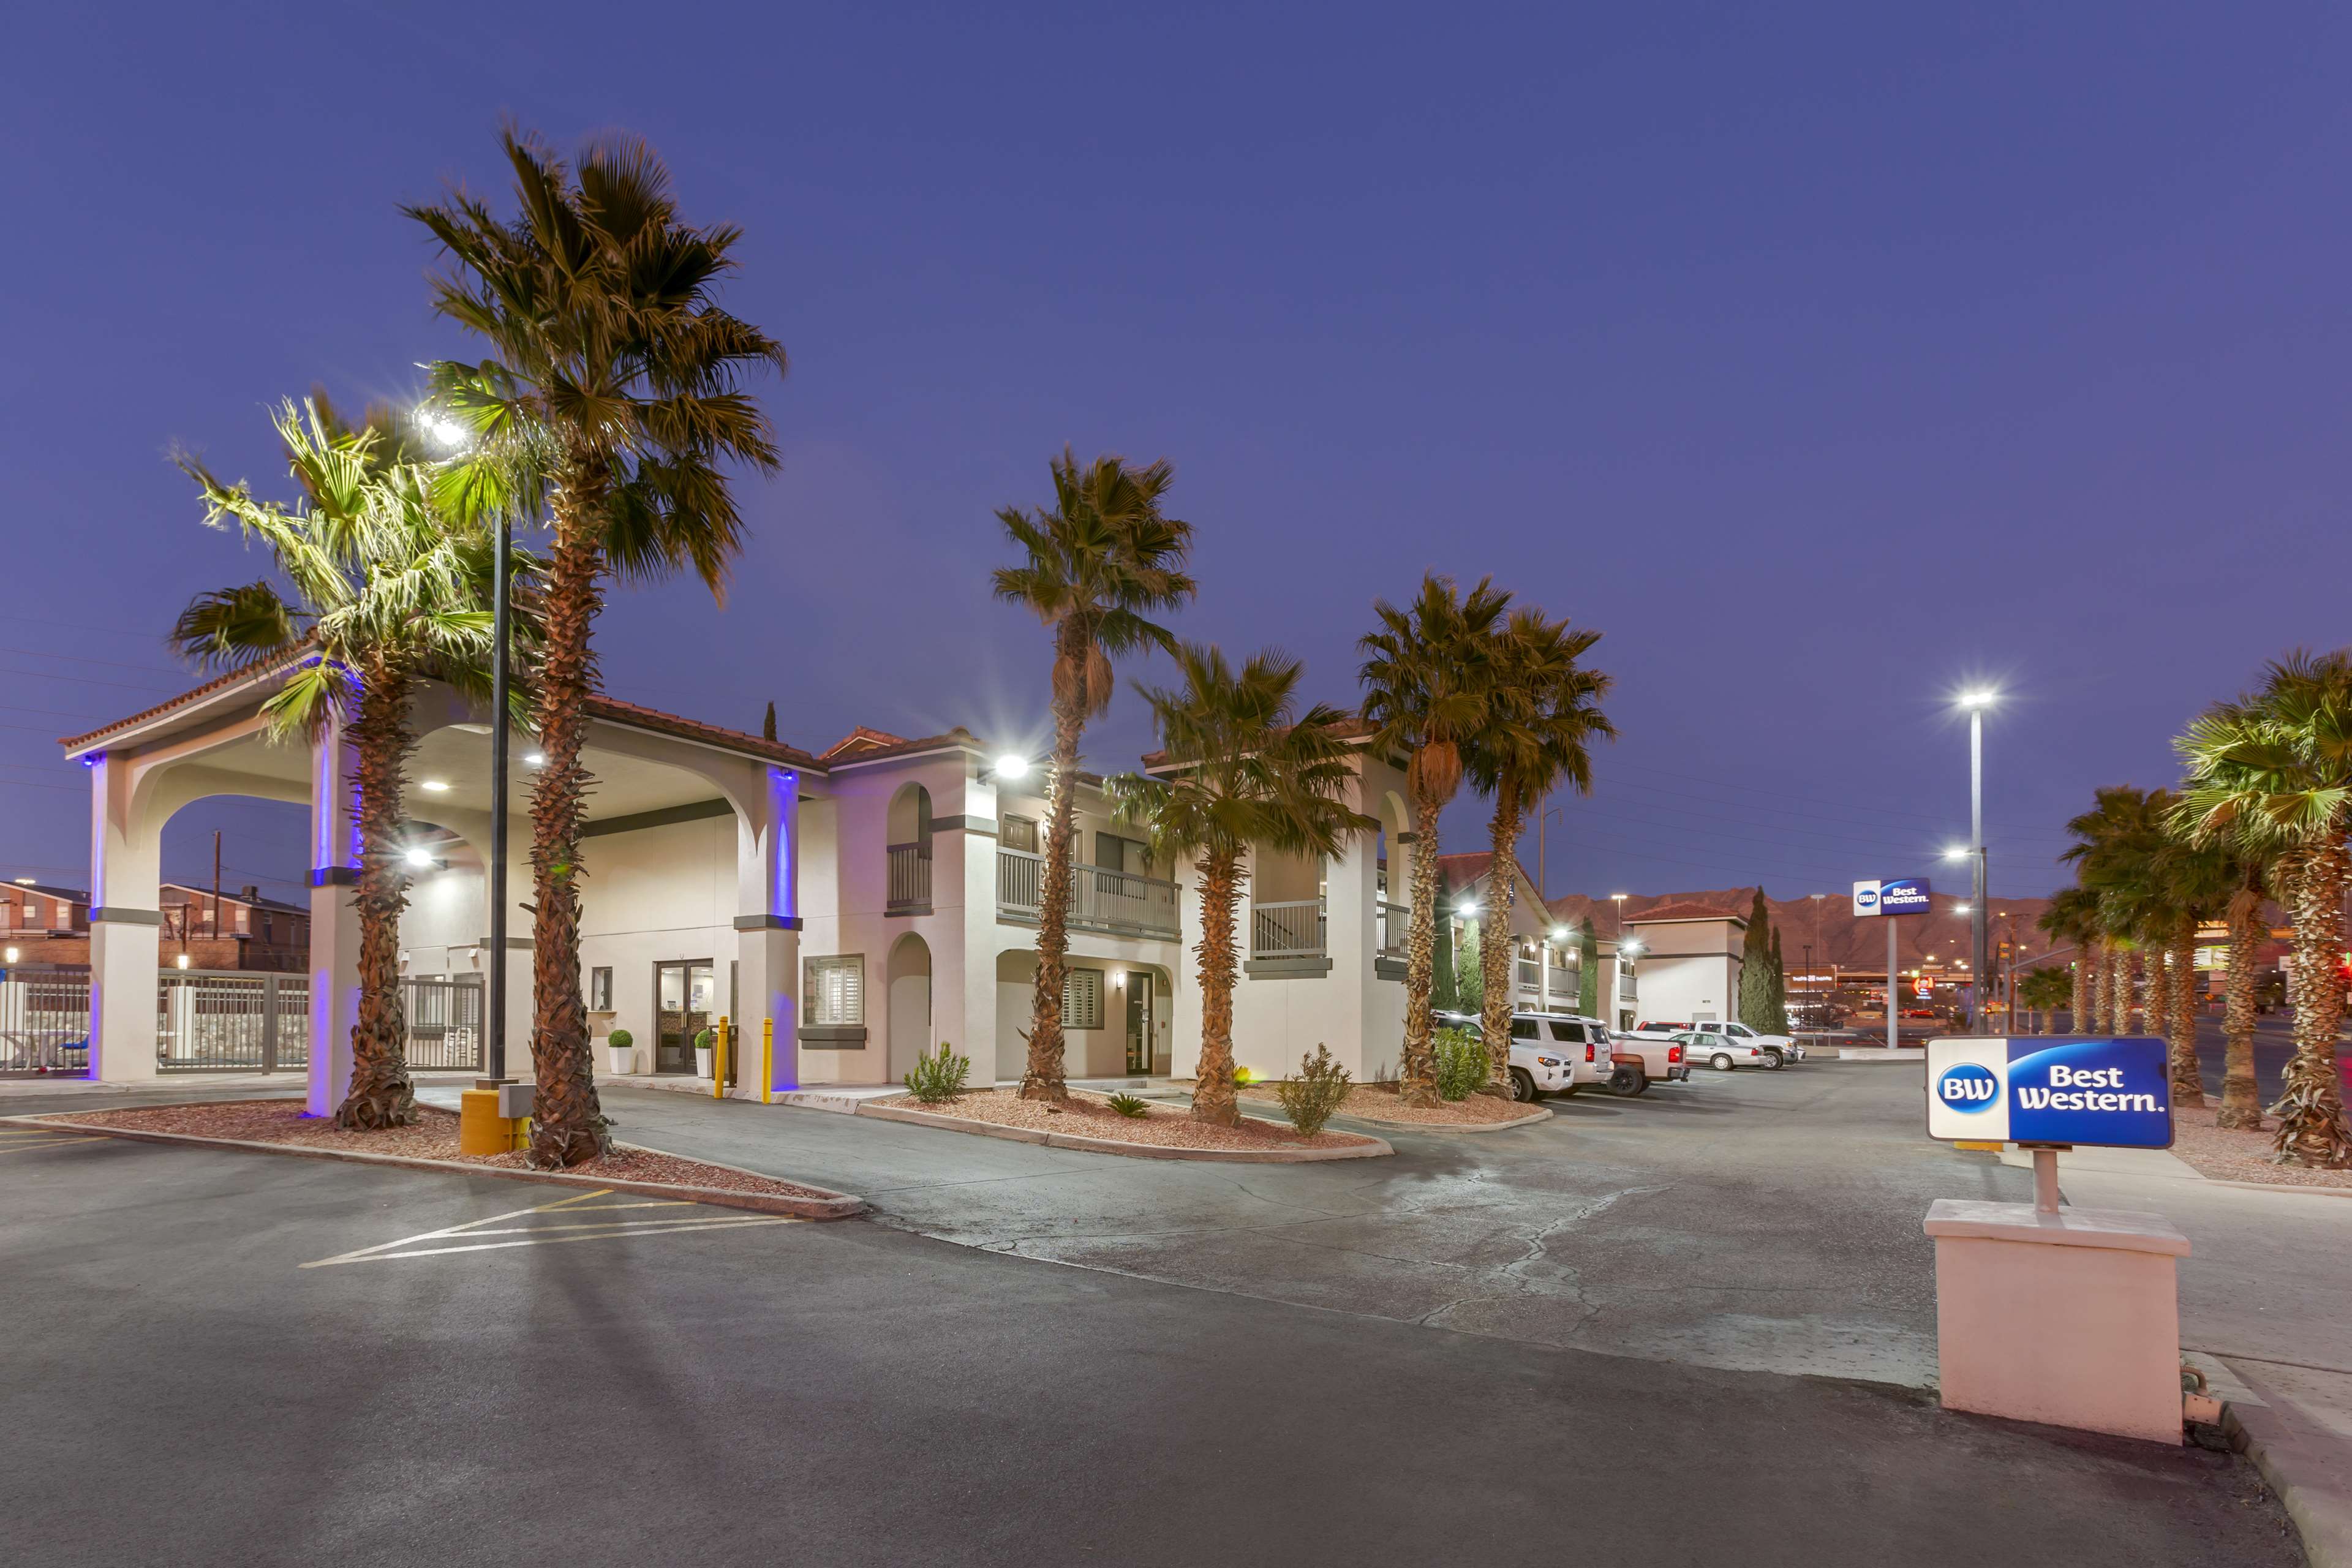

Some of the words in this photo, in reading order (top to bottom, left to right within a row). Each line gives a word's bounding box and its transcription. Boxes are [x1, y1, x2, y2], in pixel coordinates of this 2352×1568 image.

[1858, 894, 1876, 903] BW
[1893, 888, 1917, 896] Best
[2049, 1065, 2125, 1088] Best
[1943, 1077, 1994, 1101] BW
